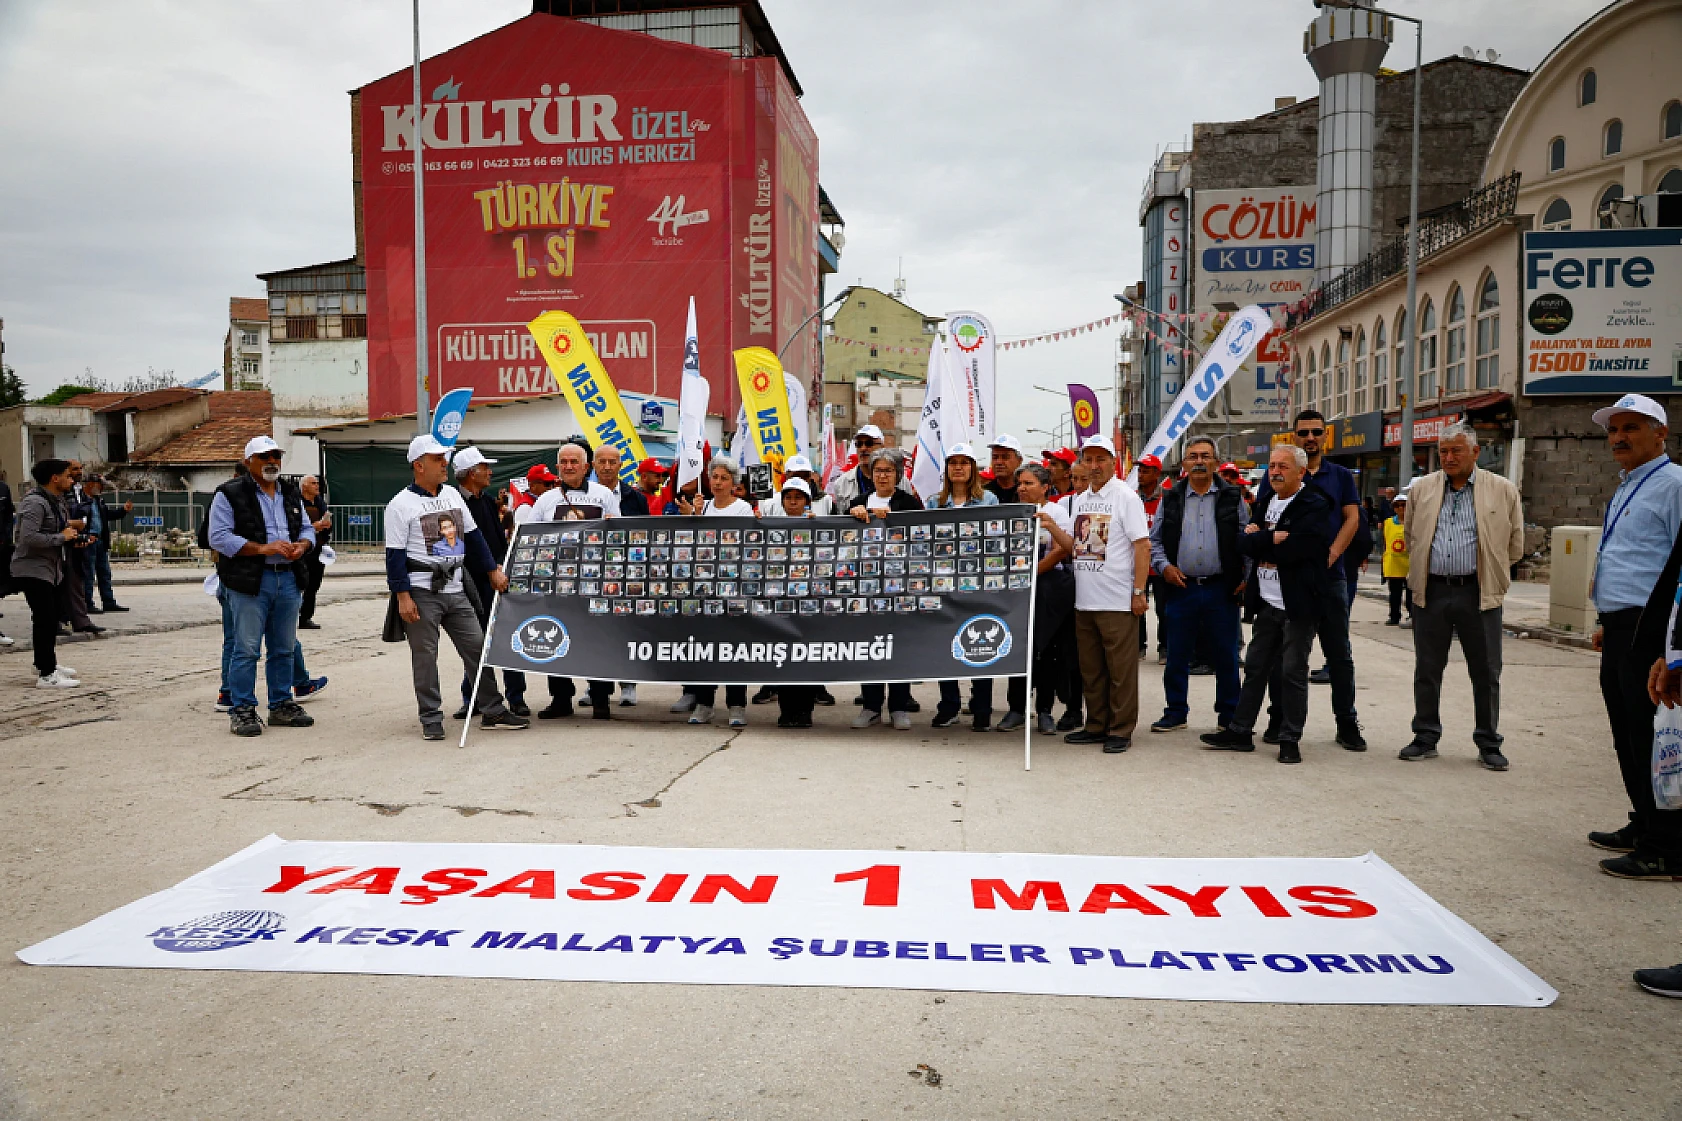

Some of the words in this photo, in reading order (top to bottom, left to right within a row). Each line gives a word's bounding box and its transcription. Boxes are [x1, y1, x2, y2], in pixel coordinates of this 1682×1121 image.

[632, 107, 695, 139] ÖZEL
[567, 146, 613, 166] KURS
[619, 139, 695, 164] MERKEZİ
[473, 176, 614, 232] TÜRKİYE
[755, 173, 771, 207] ÖZEL
[647, 194, 686, 236] 44
[1202, 195, 1317, 243] ÇÖZÜM
[512, 236, 537, 279] 1.
[547, 229, 576, 277] Sİ
[1220, 248, 1312, 269] KURS
[1527, 252, 1655, 289] Ferre
[446, 329, 537, 361] KÜLTÜR
[1530, 338, 1592, 350] MALATYA'YA
[1595, 336, 1620, 349] ÖZEL
[1623, 337, 1651, 349] AYDA
[499, 365, 564, 393] KAZA
[1528, 352, 1587, 373] 1500
[1588, 356, 1650, 372] TAKSİTLE
[628, 641, 648, 661] 10
[656, 635, 714, 662] EKİM
[719, 643, 789, 668] BARIŞ
[791, 634, 893, 662] DERNEĞİ
[263, 866, 778, 905] YAŞASIN
[834, 865, 900, 906] 1
[971, 879, 1378, 919] MAYIS
[295, 926, 462, 947] KESK
[471, 931, 745, 955] MALATYA
[769, 938, 1051, 962] ŞUBELER
[1069, 948, 1455, 975] PLATFORMU
